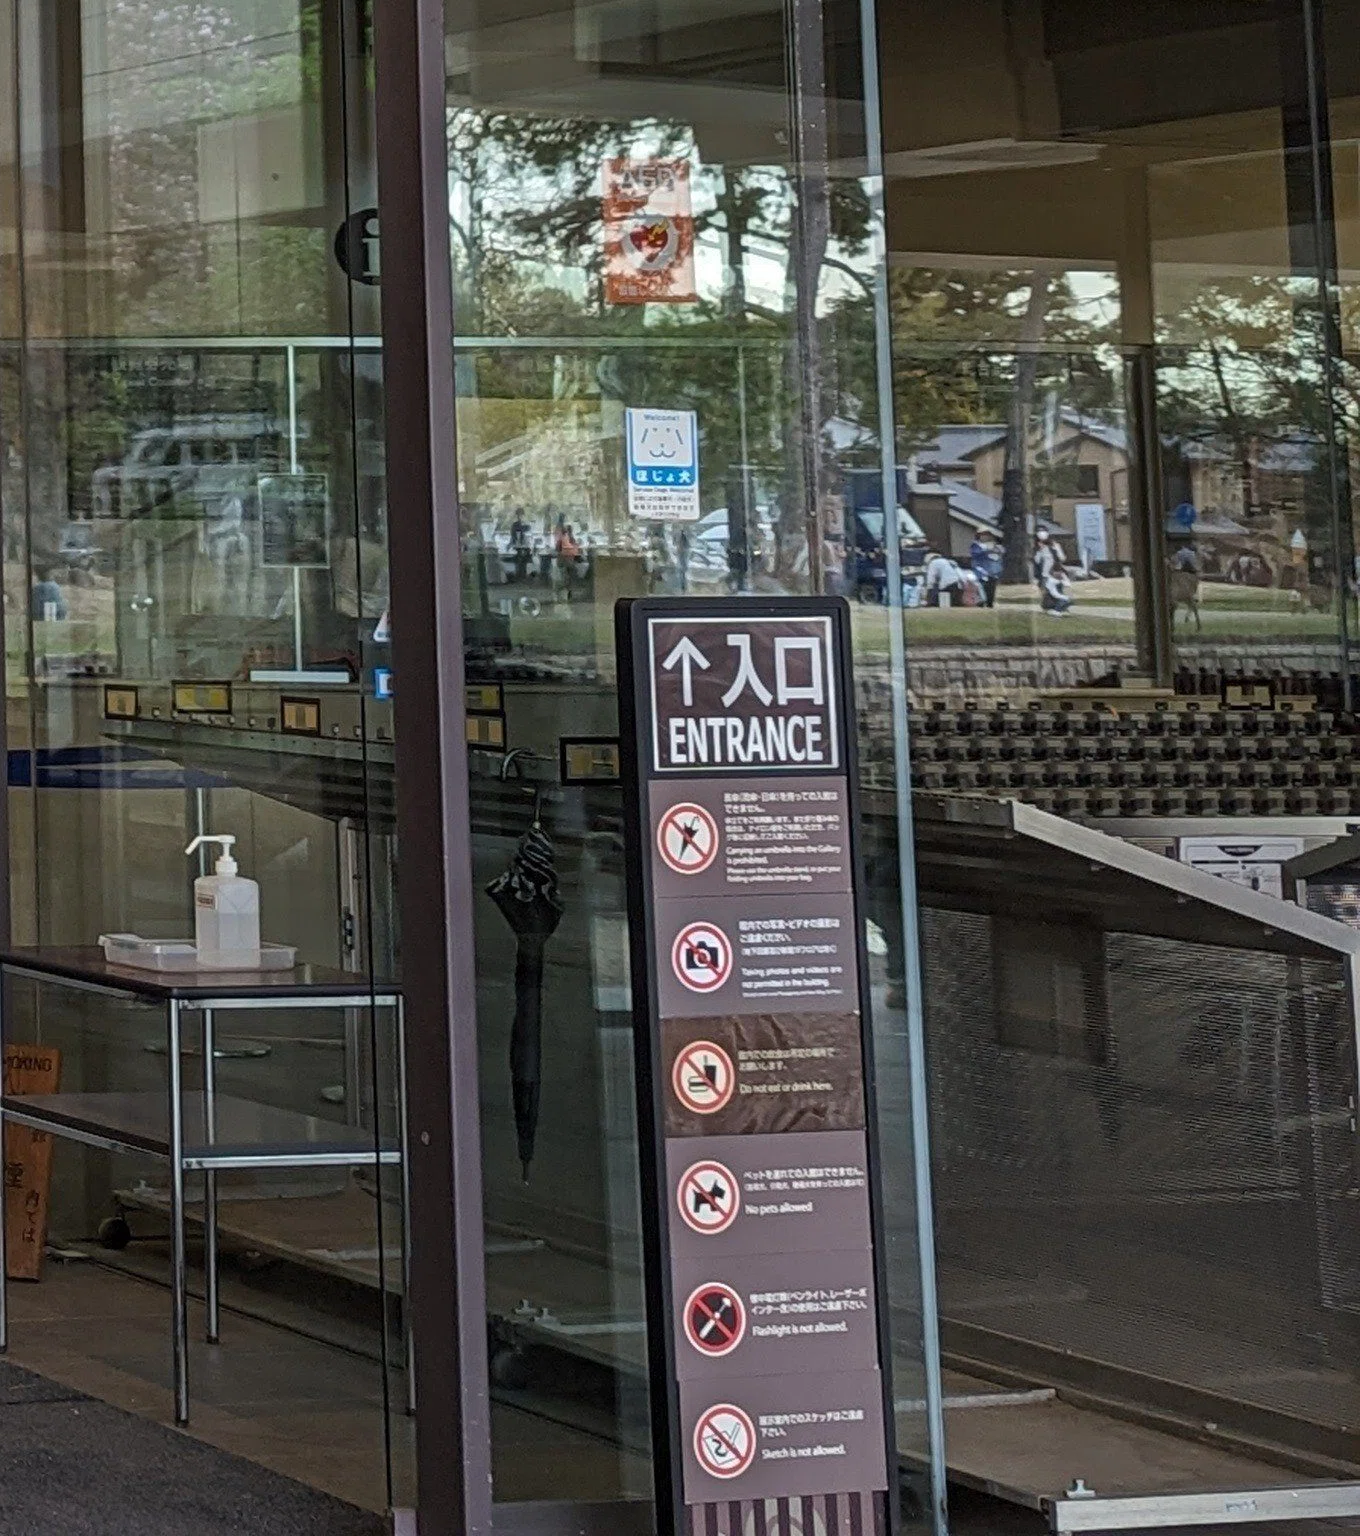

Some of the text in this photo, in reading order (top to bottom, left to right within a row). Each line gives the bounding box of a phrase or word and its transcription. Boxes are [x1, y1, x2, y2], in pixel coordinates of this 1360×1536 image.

[635, 469, 691, 484] ほじょ犬
[720, 633, 824, 708] 入口
[668, 714, 824, 764] ENTRANCE
[745, 1202, 814, 1216] No pets allowed
[762, 1448, 789, 1459] Sketch
